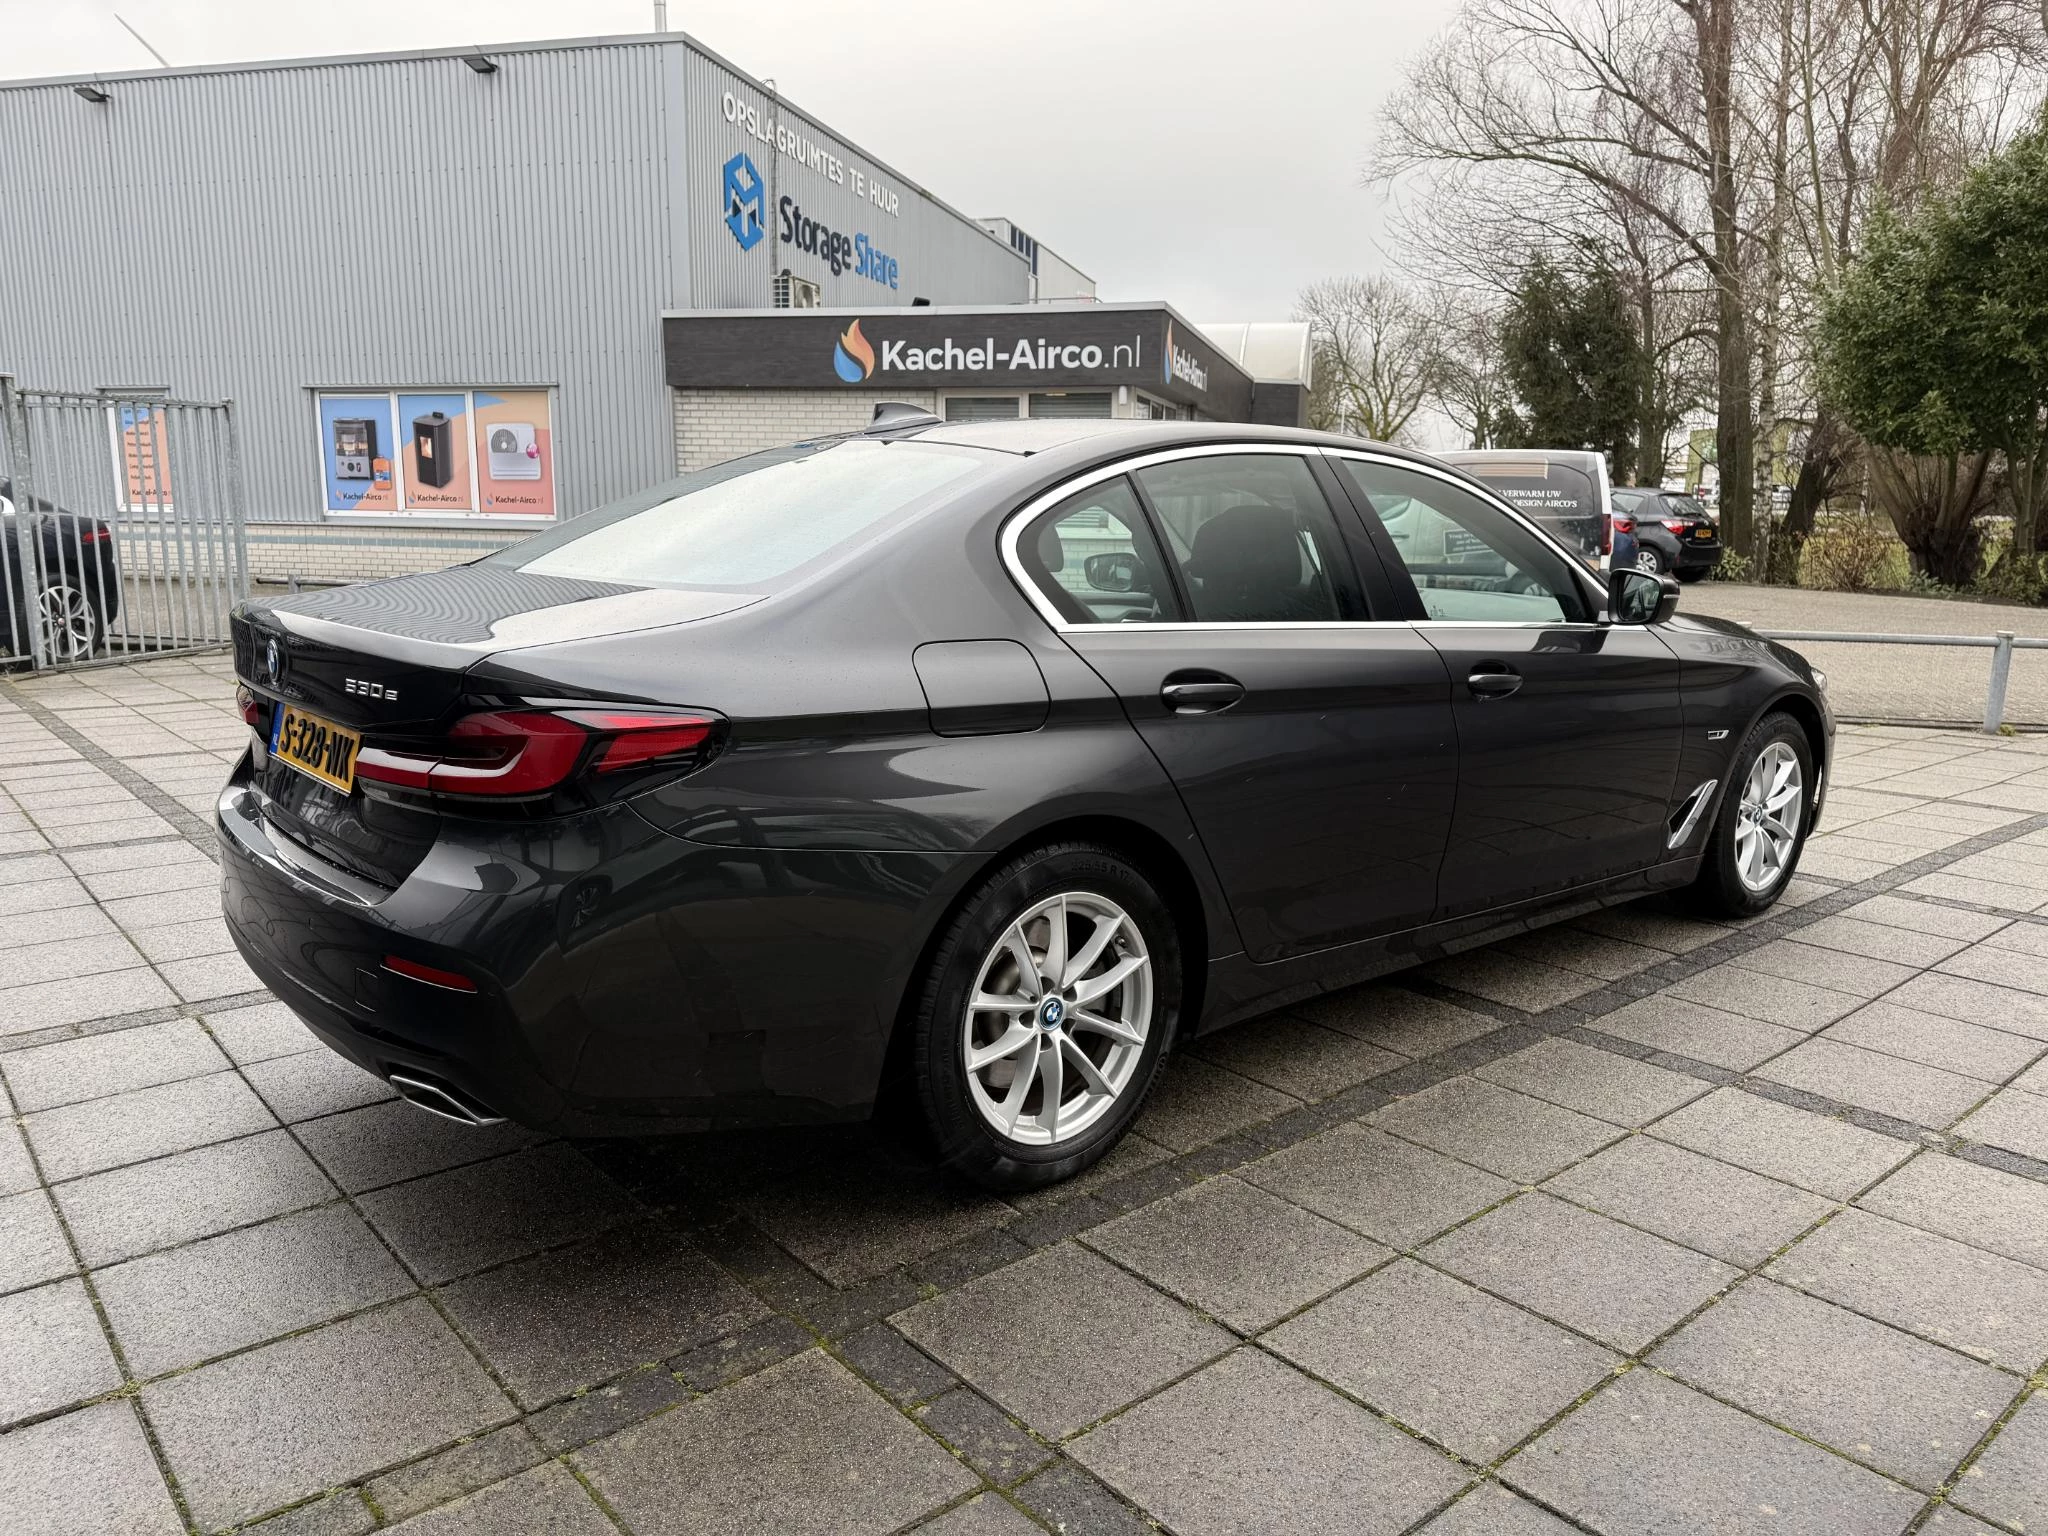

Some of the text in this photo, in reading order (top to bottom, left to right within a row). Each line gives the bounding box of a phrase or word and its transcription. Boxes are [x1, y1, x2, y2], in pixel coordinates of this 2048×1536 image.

[722, 91, 899, 217] OPSLAGRUIMTES TE HUUR
[780, 195, 898, 289] Storage Share
[881, 334, 1141, 371] Kachel-Airco.nl
[1502, 489, 1562, 498] VERWARM UW
[1545, 500, 1578, 508] AIRCO'S
[280, 713, 354, 783] S-328-NK
